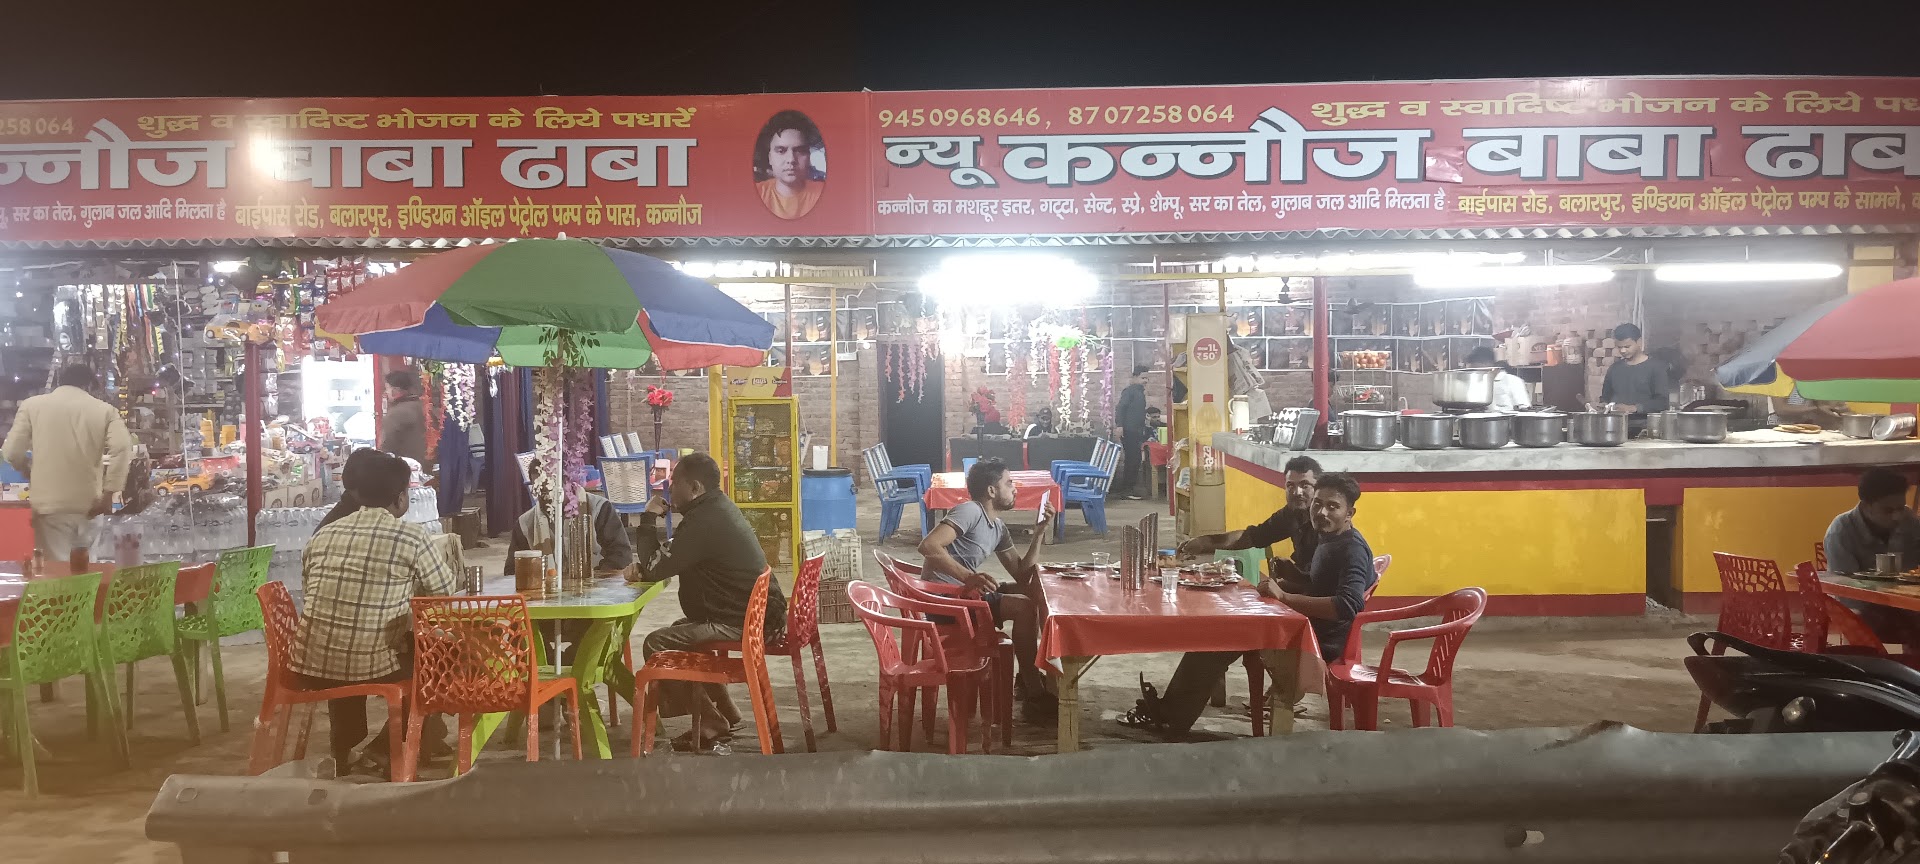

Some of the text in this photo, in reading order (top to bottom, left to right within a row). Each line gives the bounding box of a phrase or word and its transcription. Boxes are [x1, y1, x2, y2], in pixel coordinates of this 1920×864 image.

[137, 114, 202, 138] शुद्ध
[210, 115, 236, 129] व
[377, 108, 480, 129] भोजन
[488, 108, 524, 129] के
[533, 106, 603, 129] लिये
[611, 107, 698, 128] पधारें
[1068, 104, 1235, 125] 8707258064
[1311, 101, 1390, 127] शुद्ध
[1399, 101, 1431, 116] व
[1440, 92, 1589, 115] स्वादिष्ट
[1596, 92, 1720, 114] भोजन
[1730, 91, 1773, 113] के
[1784, 91, 1864, 113] लिये
[497, 138, 698, 190] ढाबा
[881, 134, 999, 188] न्यू
[998, 106, 1433, 188] कन्नौज
[1462, 126, 1714, 179] बाबा
[33, 205, 50, 221] का
[80, 204, 115, 228] गुलाब
[117, 204, 142, 220] जल
[144, 198, 173, 220] आदि
[175, 198, 213, 220] मिलता
[213, 197, 226, 221] है
[235, 196, 291, 229] बाईपास
[397, 196, 457, 229] इण्डियन
[461, 198, 506, 229] ऑइल
[509, 196, 549, 236] पेट्रोल
[552, 204, 582, 226] पम्प
[586, 196, 603, 227] के
[606, 204, 641, 228] पास,
[645, 195, 703, 226] कन्नौज
[877, 194, 928, 216] कन्नौज
[933, 199, 952, 216] का
[955, 199, 998, 222] मशहूर
[1189, 196, 1211, 212] सर
[1213, 195, 1233, 211] का
[1271, 194, 1312, 219] गुलाब
[1316, 194, 1345, 211] जल
[1348, 188, 1381, 210] आदि
[1384, 188, 1430, 210] मिलता
[1458, 188, 1518, 216] बाईपास
[1631, 185, 1696, 213] इण्डियन
[1699, 187, 1747, 213] ऑइल
[1750, 186, 1794, 217] पेट्रोल
[1798, 191, 1830, 209] पम्प
[1833, 185, 1852, 209] के
